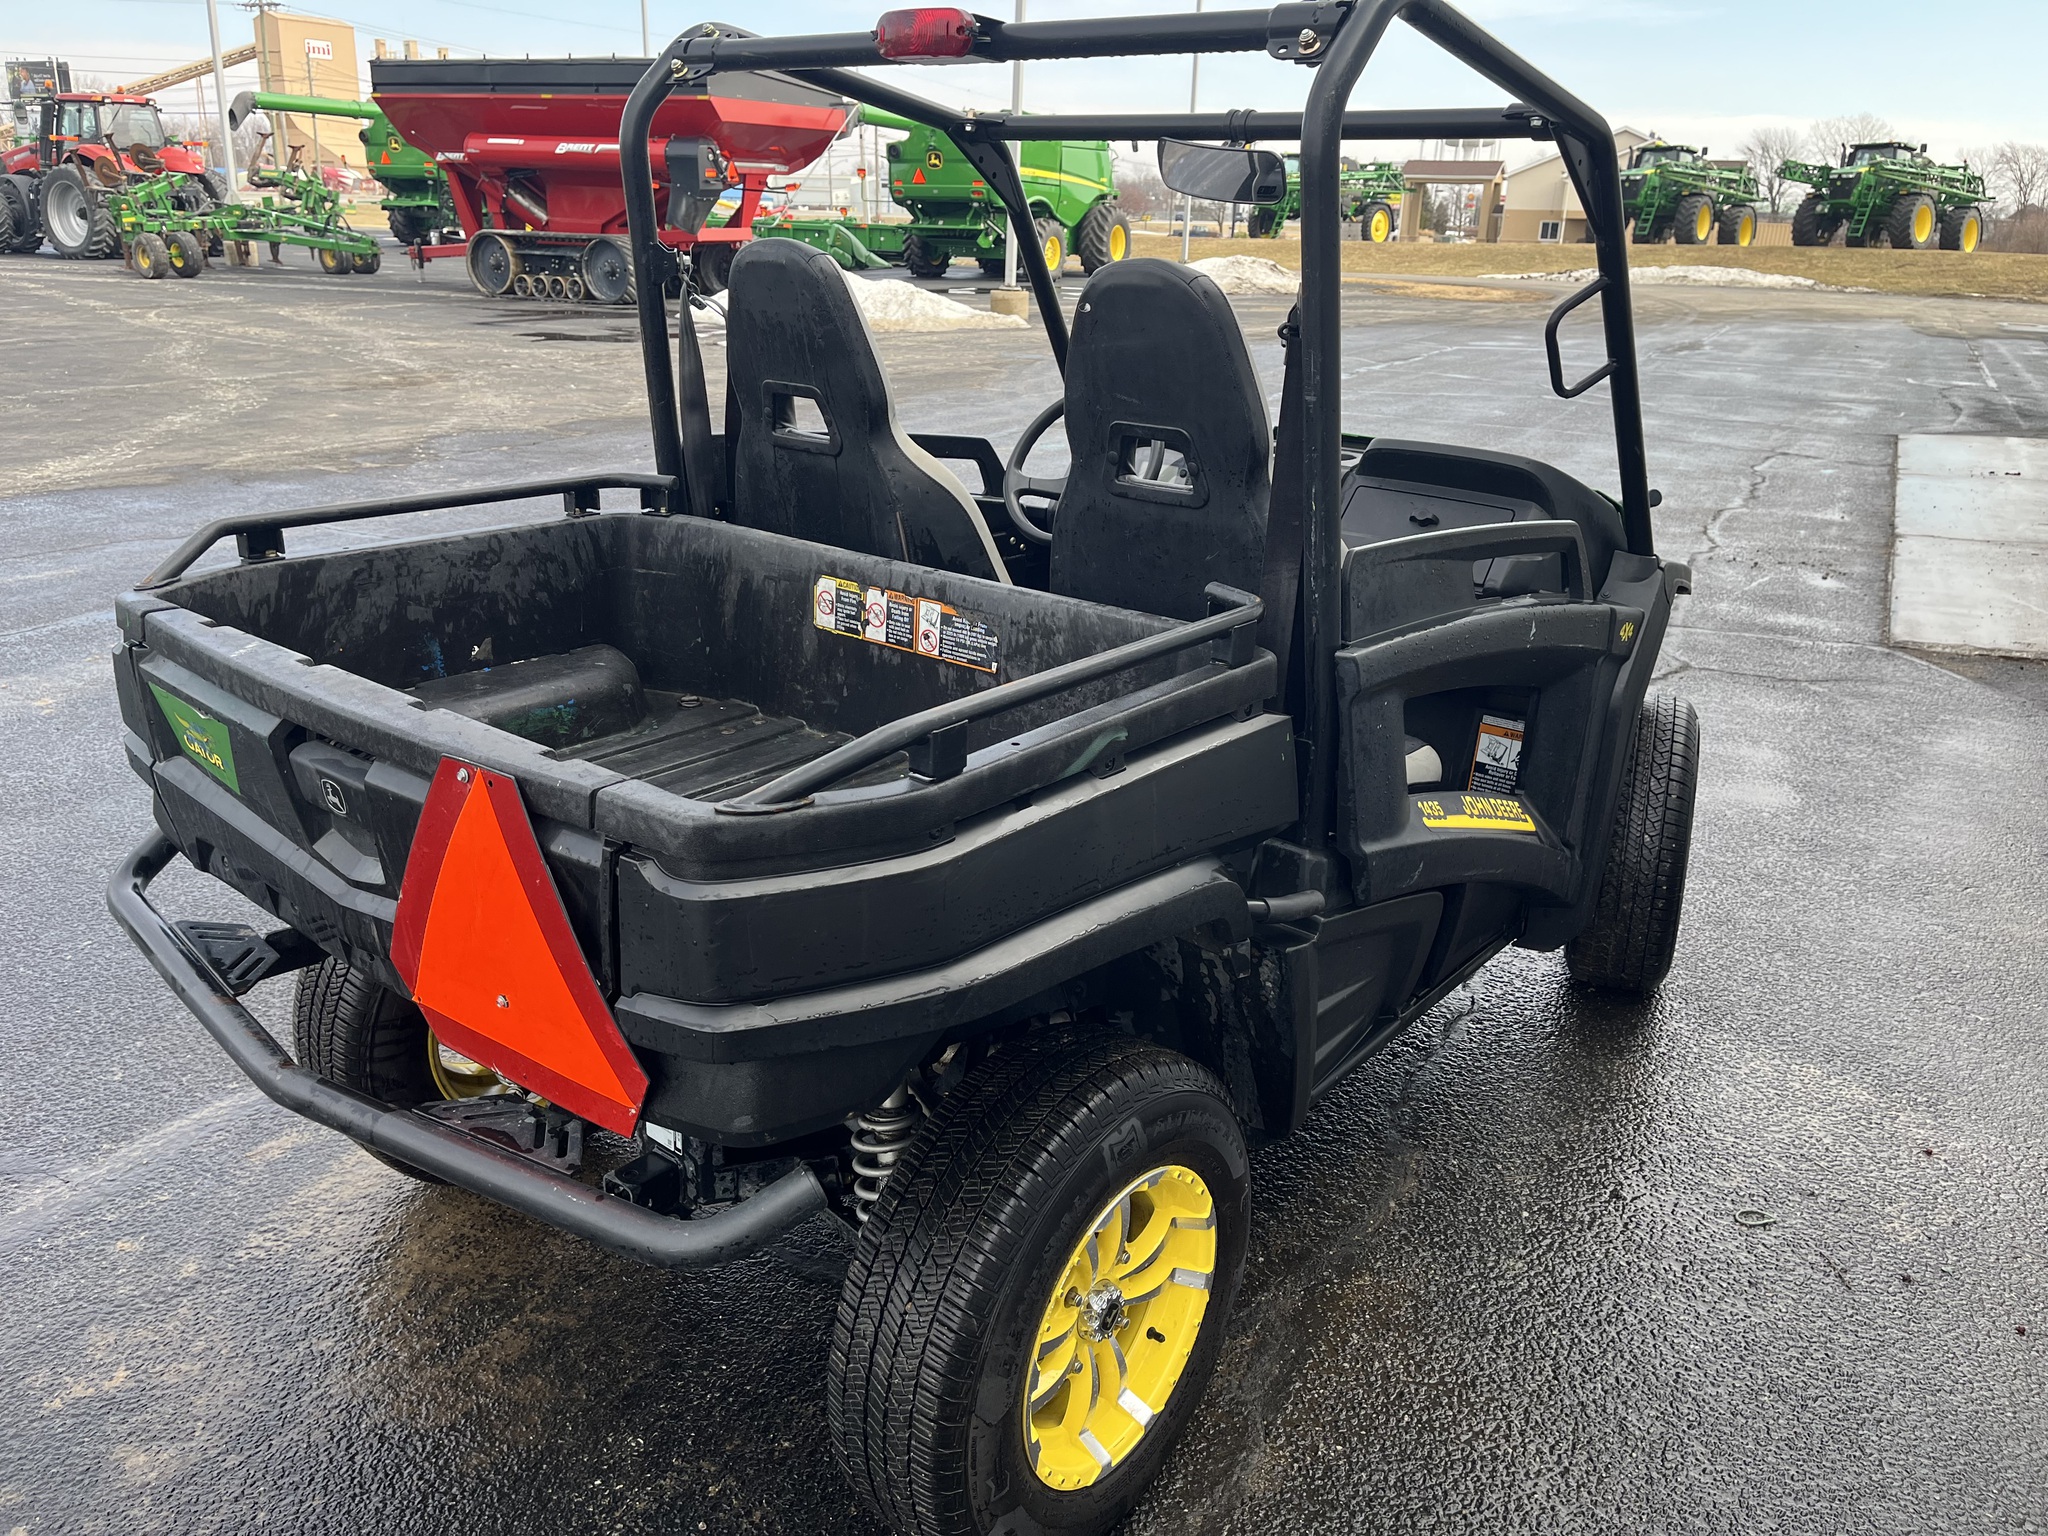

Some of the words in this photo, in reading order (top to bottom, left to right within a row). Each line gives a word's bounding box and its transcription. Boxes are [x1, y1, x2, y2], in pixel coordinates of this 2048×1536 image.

[555, 143, 595, 154] BRENT
[183, 734, 225, 770] GATOR
[1461, 795, 1494, 816] JOHN
[1489, 798, 1526, 819] DEERE
